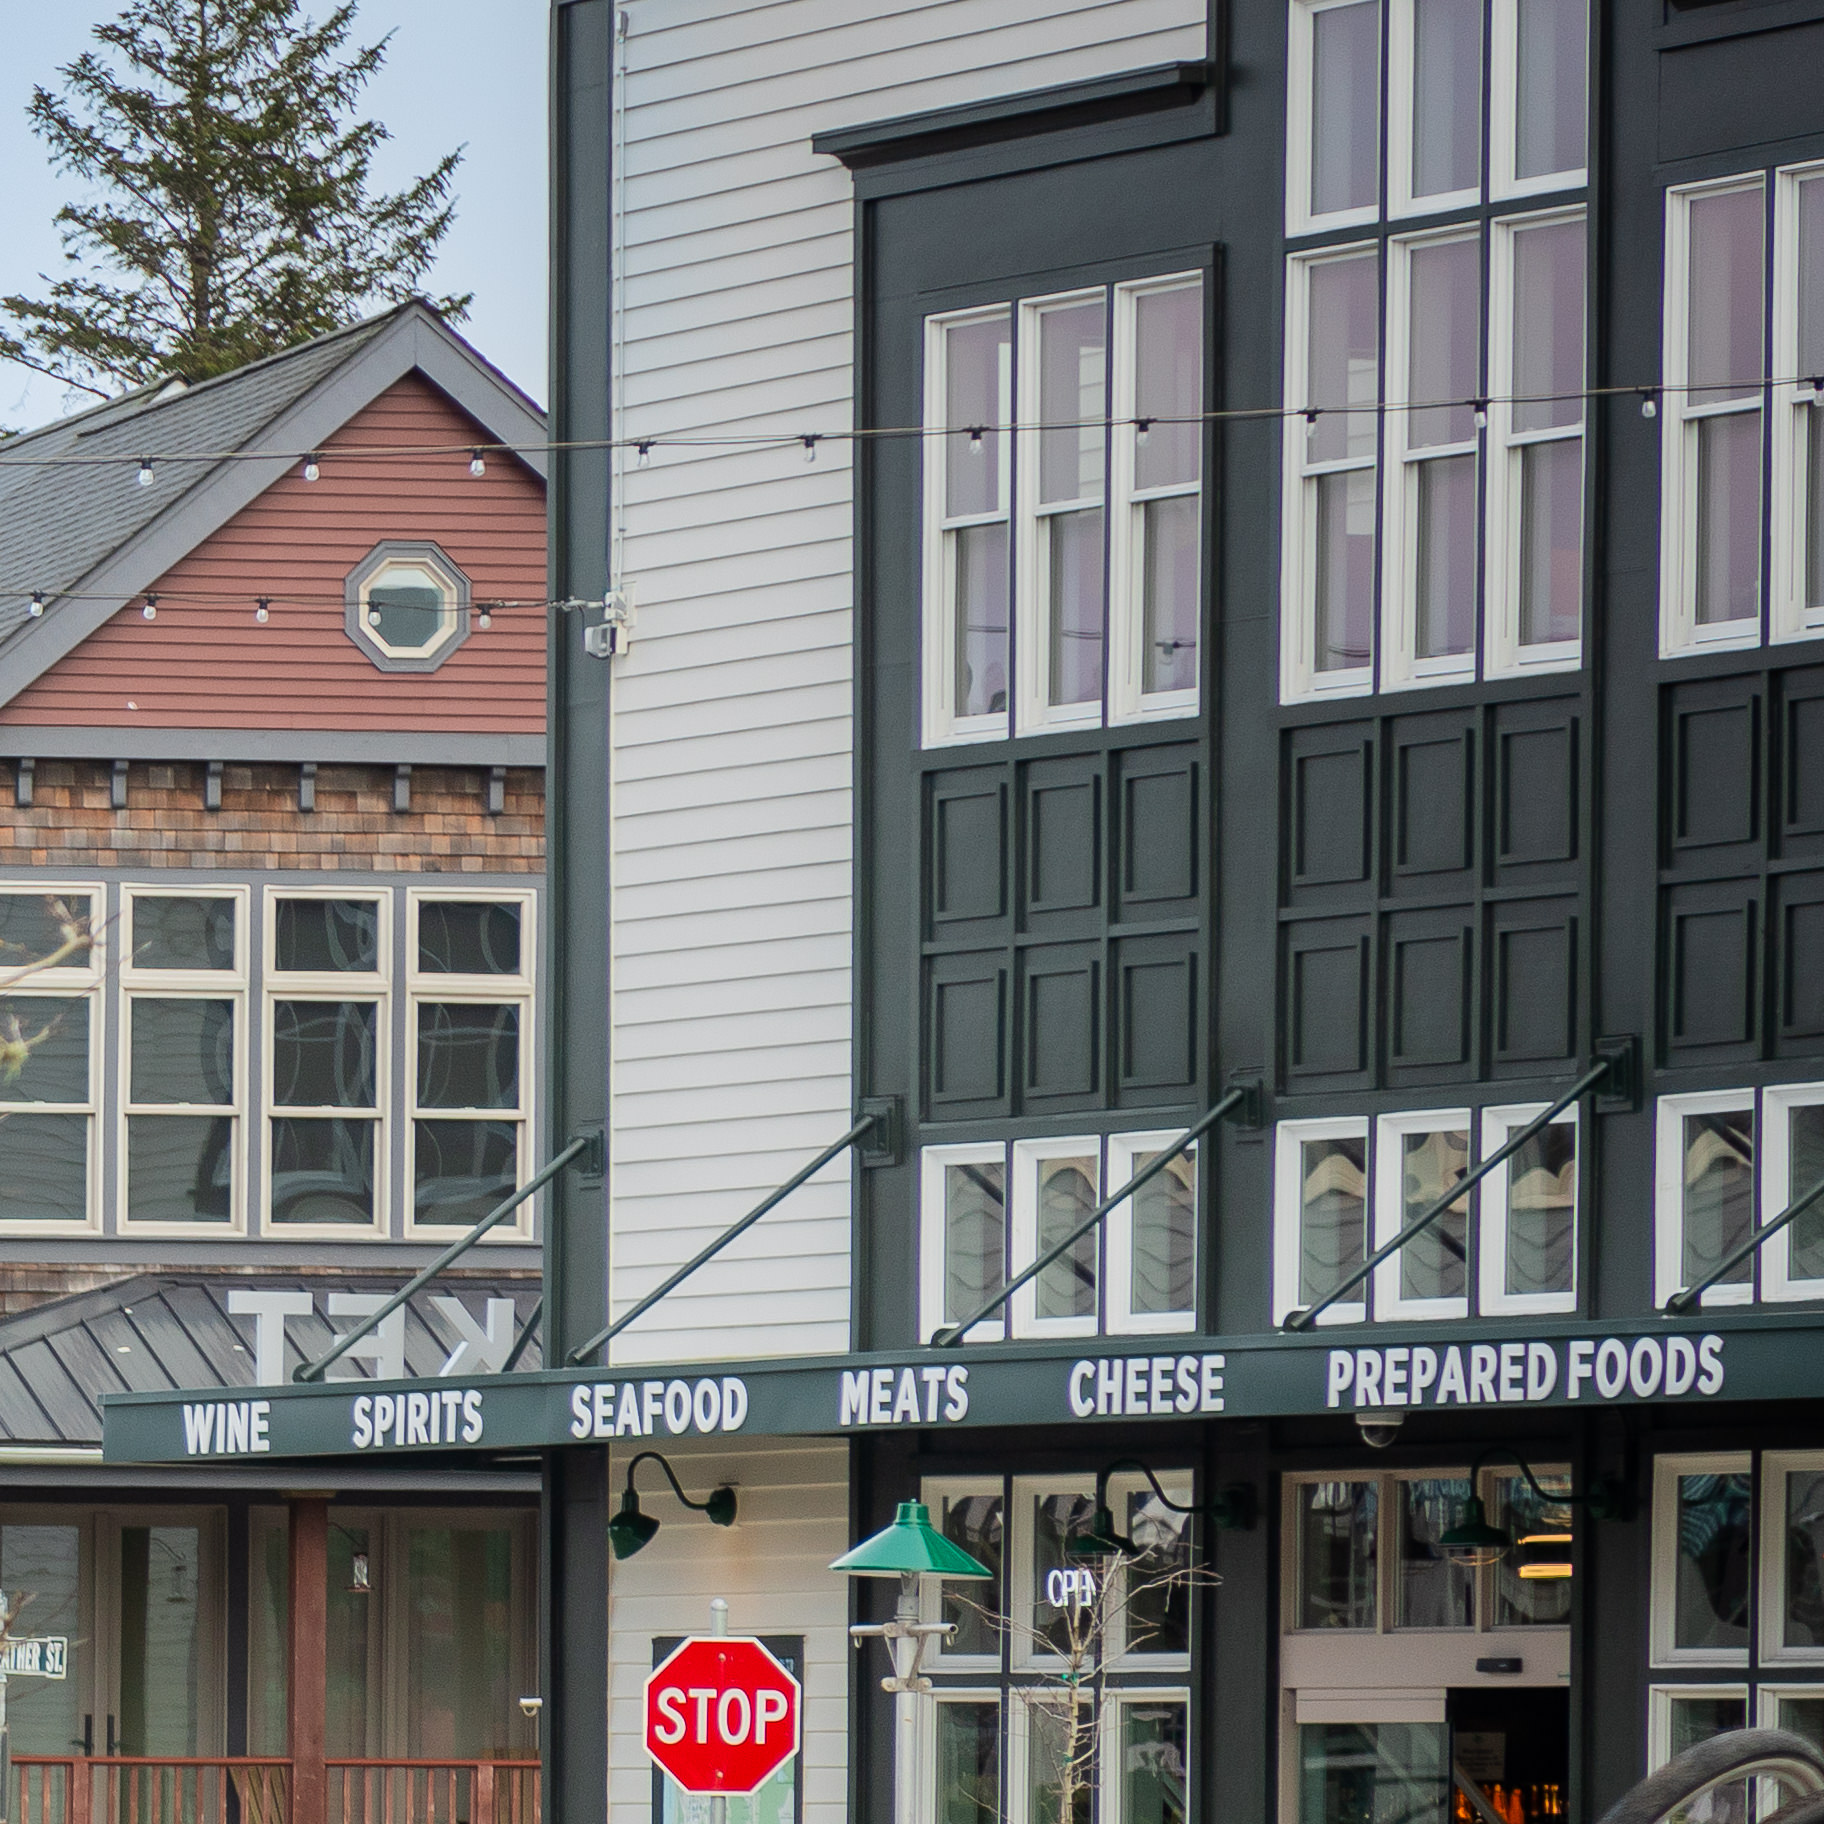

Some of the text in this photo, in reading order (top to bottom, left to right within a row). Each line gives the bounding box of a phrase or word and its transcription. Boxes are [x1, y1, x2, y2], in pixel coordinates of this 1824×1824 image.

[184, 1335, 1725, 1455] WINE SPIRITS SEAFOOD MEATS CHEESE PREPARED FOODS
[655, 1686, 789, 1746] STOP
